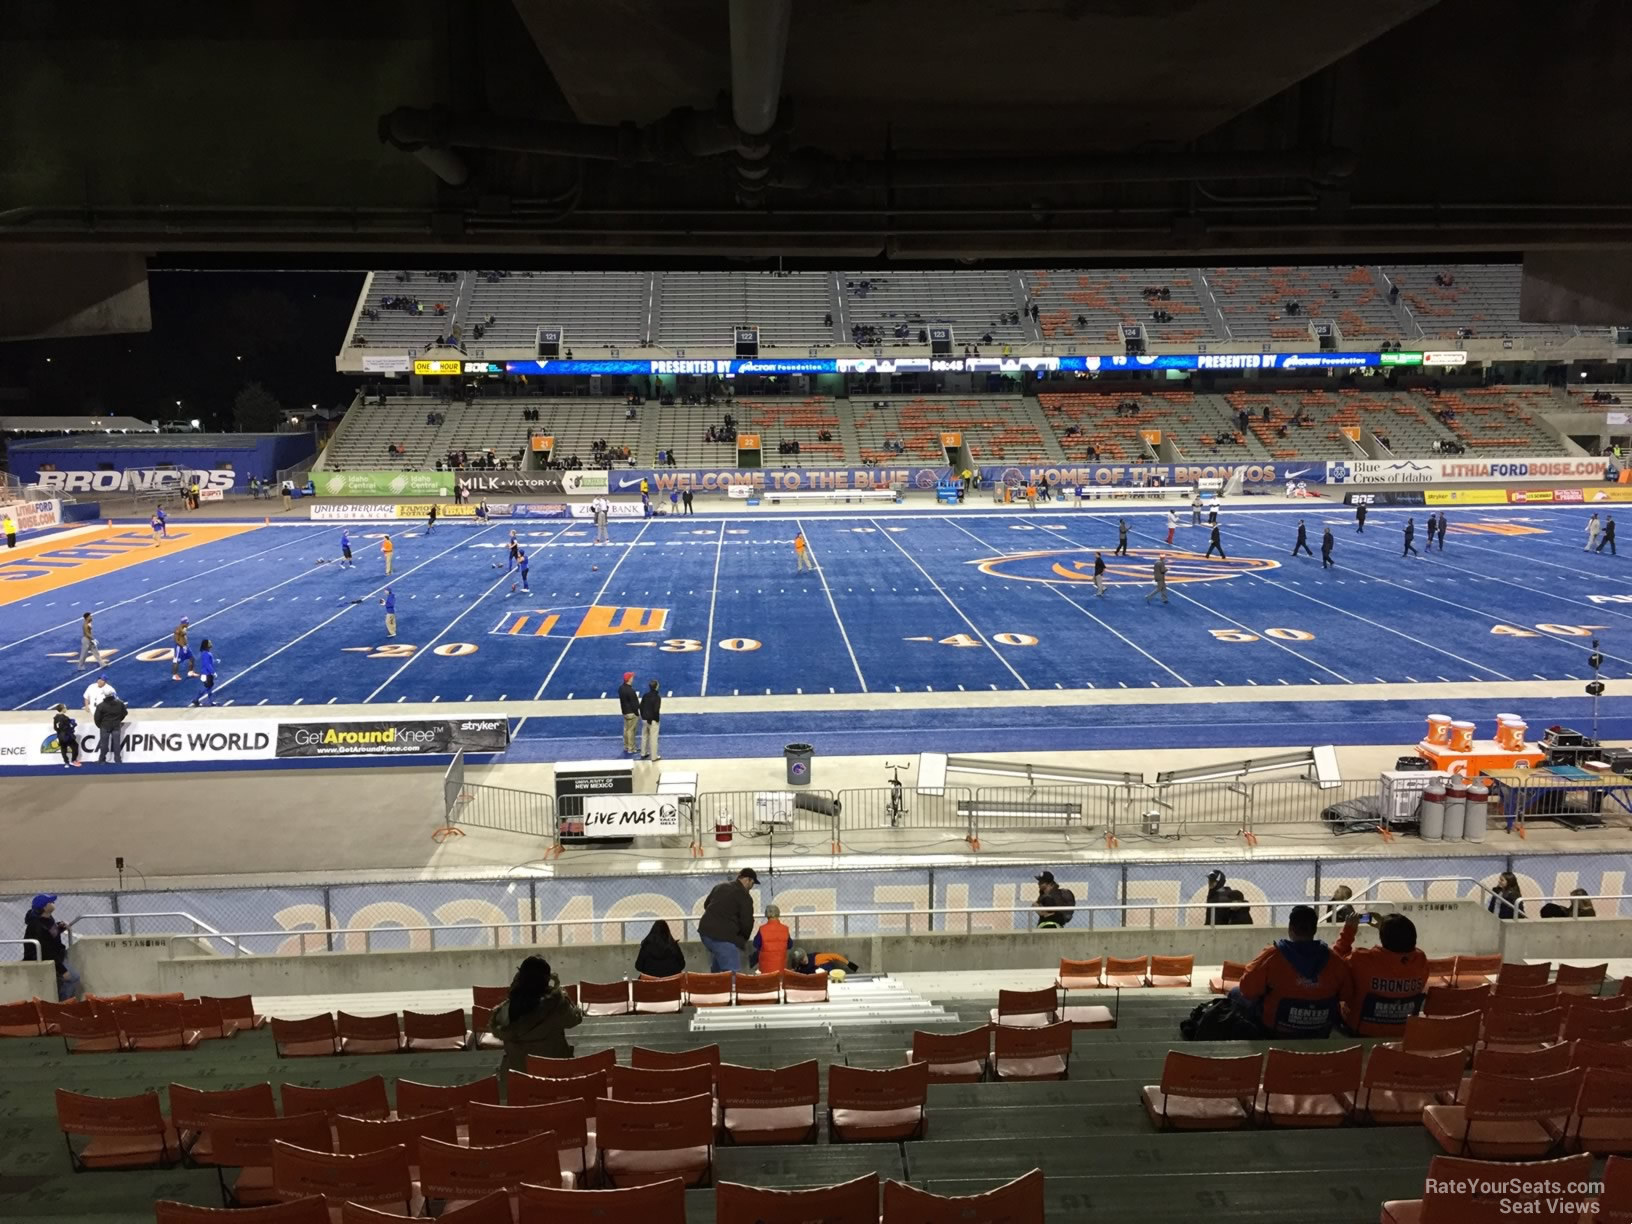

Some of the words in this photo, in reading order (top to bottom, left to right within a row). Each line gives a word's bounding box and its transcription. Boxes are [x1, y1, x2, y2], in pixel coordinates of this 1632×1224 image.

[651, 361, 715, 373] PRESENTED
[717, 361, 731, 373] BY
[1198, 355, 1260, 368] PRESENTED
[1262, 355, 1277, 367] BY
[1353, 462, 1380, 473] Blue
[1442, 463, 1606, 478] LITHIAFORDBOISE.COM
[36, 470, 235, 491] BRONCOS
[653, 473, 766, 490] WELCOME
[771, 472, 801, 490] TO
[806, 472, 849, 489] THE
[854, 470, 910, 488] BLUE
[1030, 468, 1090, 485] HOME
[1095, 467, 1125, 484] OF
[1132, 467, 1169, 483] THE
[1174, 465, 1276, 483] BRONCOS
[1353, 473, 1384, 483] Cross
[1387, 472, 1400, 482] of
[1401, 472, 1433, 483] Idaho
[459, 477, 499, 490] MILK
[314, 505, 349, 513] UNITED
[352, 504, 394, 513] HERITAGE
[612, 505, 640, 513] BANK
[461, 721, 500, 735] stryker
[188, 733, 270, 757] WORLD
[317, 745, 420, 754] www.GetAroundKnee.com
[620, 808, 656, 826] MÁS
[1371, 977, 1424, 993] BRONCOS
